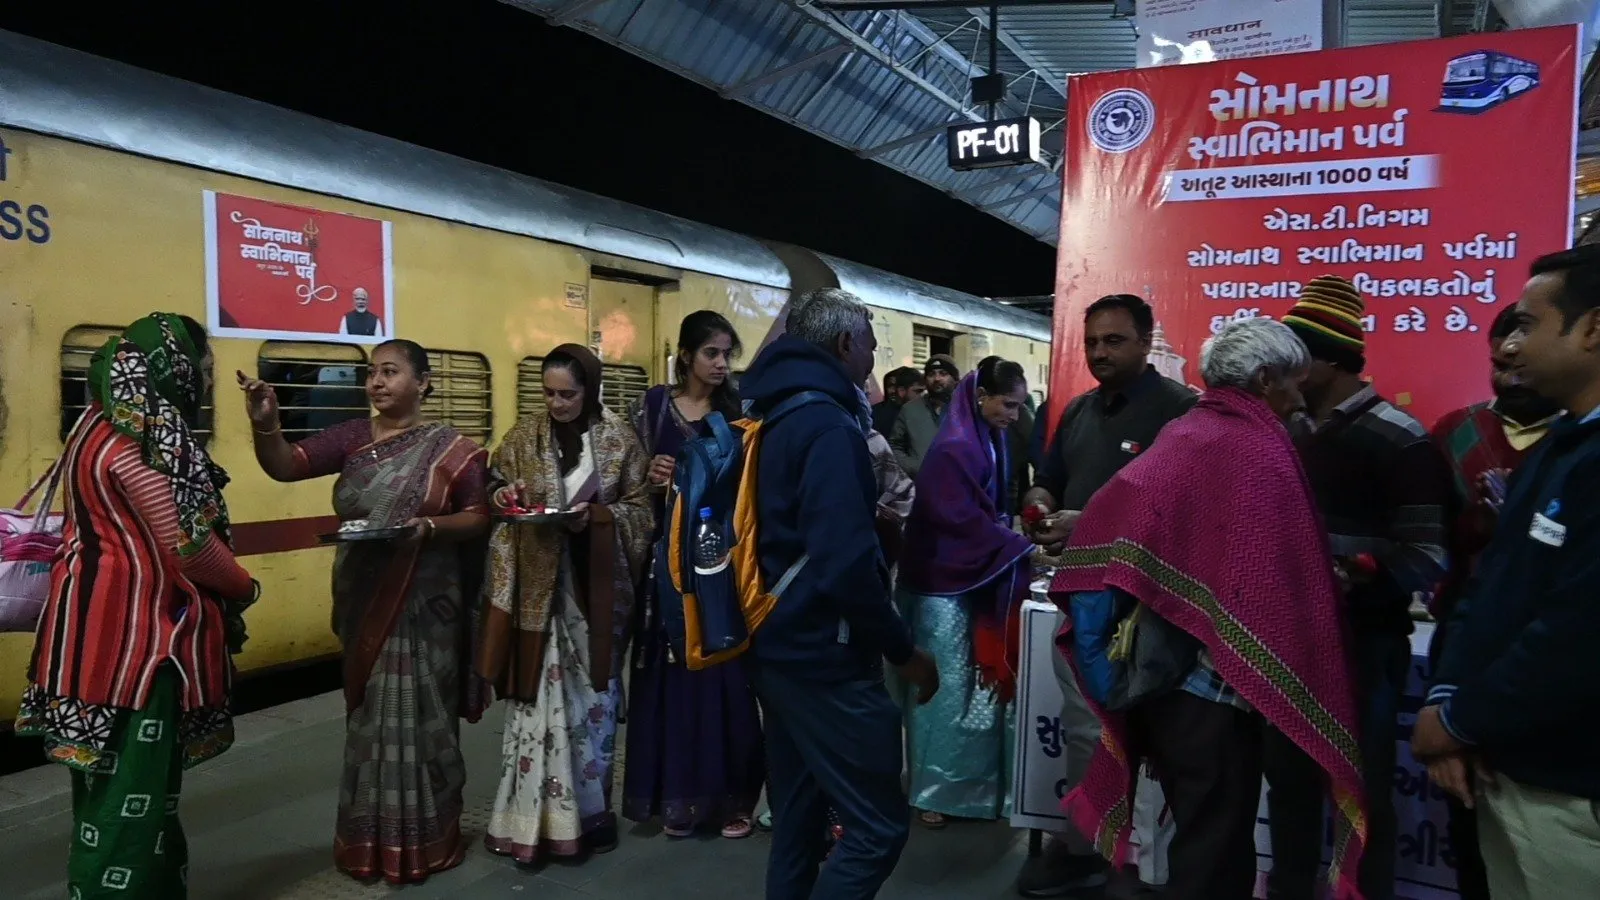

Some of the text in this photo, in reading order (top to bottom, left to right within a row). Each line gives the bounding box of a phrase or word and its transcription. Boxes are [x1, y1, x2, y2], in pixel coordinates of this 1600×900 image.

[1187, 19, 1263, 39] सावधान
[1208, 71, 1389, 122] સોમનાથ
[957, 123, 1020, 159] PF-01
[1187, 120, 1344, 161] સ્વાભિમાન
[1352, 108, 1409, 149] પર્વ
[1181, 158, 1411, 198] અતૂટ આસ્થાના 1000 વર્ષ
[234, 213, 303, 245] सोमनाथ
[240, 242, 312, 265] स्वाभिमान
[1187, 232, 1517, 268] સોમનાથ સ્વાભિમાન પર્વમાં
[1202, 269, 1497, 303] પધારનાર વિકભકતોનું
[1394, 306, 1427, 332] કરે
[1444, 305, 1479, 332] છે.
[1037, 716, 1068, 759] સુ
